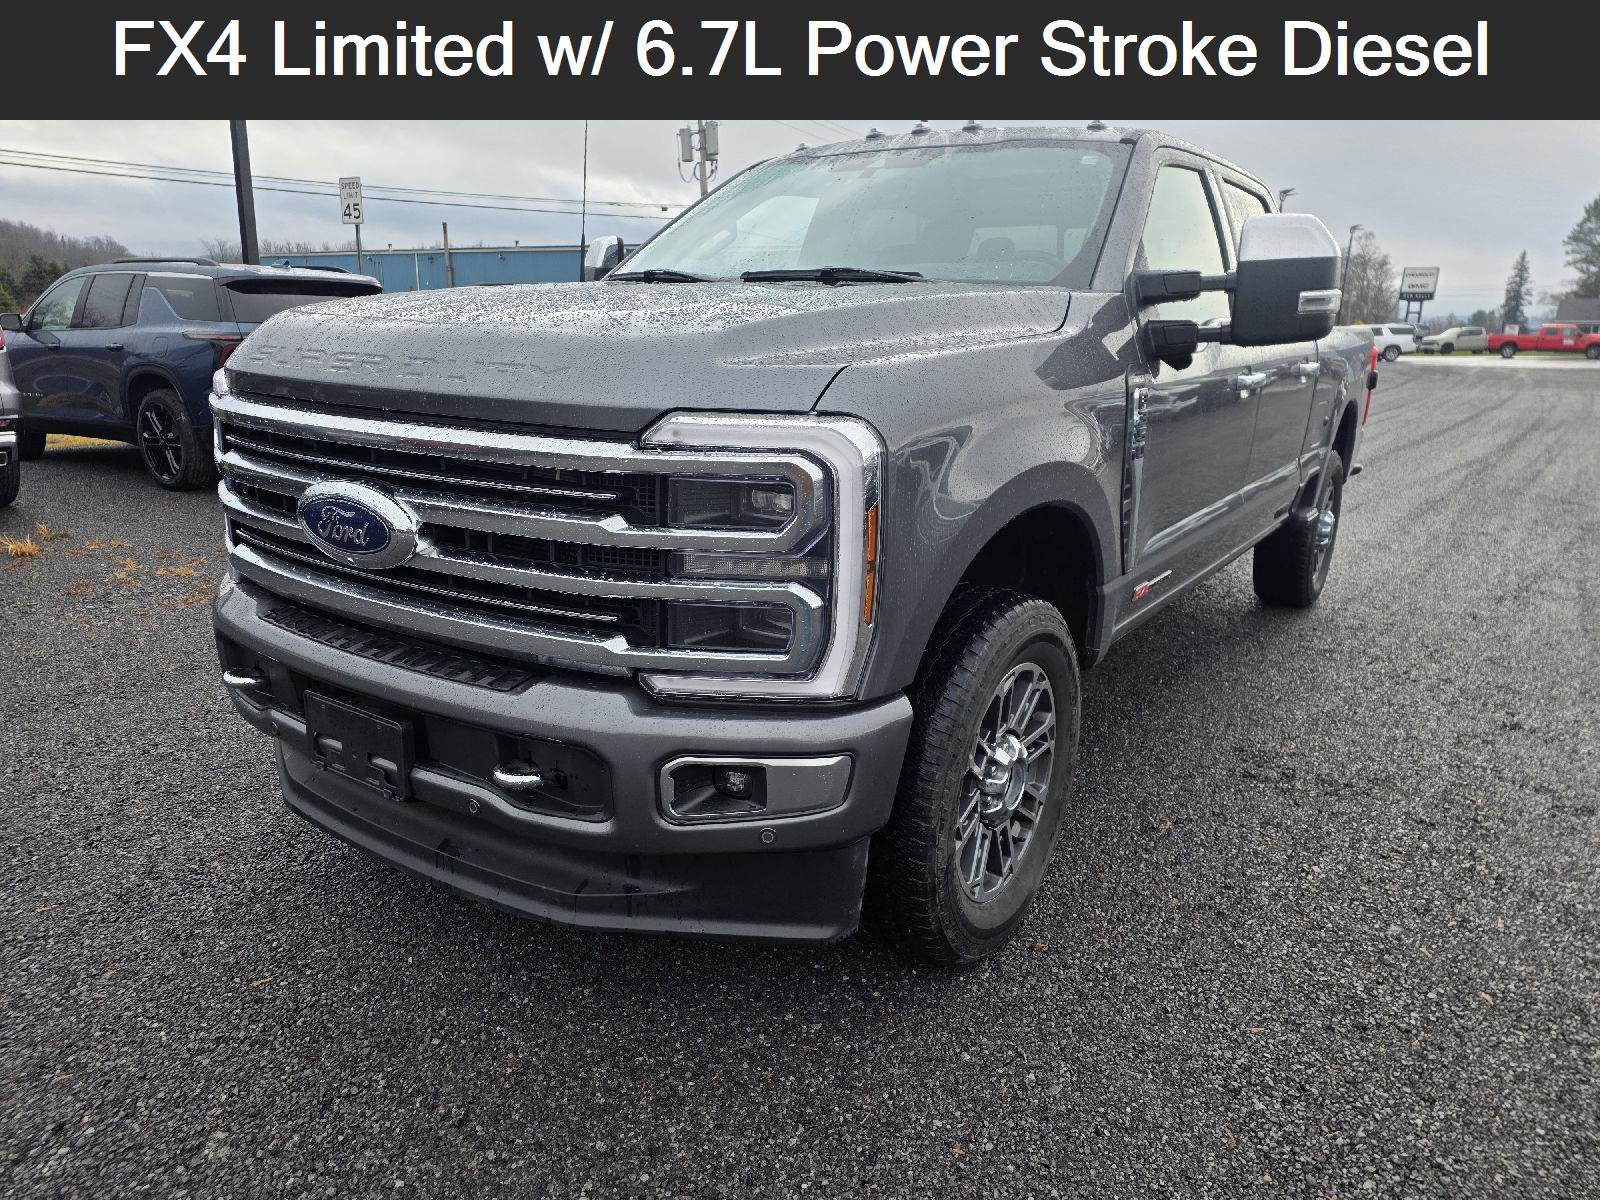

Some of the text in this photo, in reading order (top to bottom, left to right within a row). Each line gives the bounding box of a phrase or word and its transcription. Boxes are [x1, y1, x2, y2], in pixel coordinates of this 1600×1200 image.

[341, 181, 360, 190] SPEED
[343, 202, 361, 220] 45
[248, 344, 391, 376] SUPER
[317, 505, 371, 547] Ford
